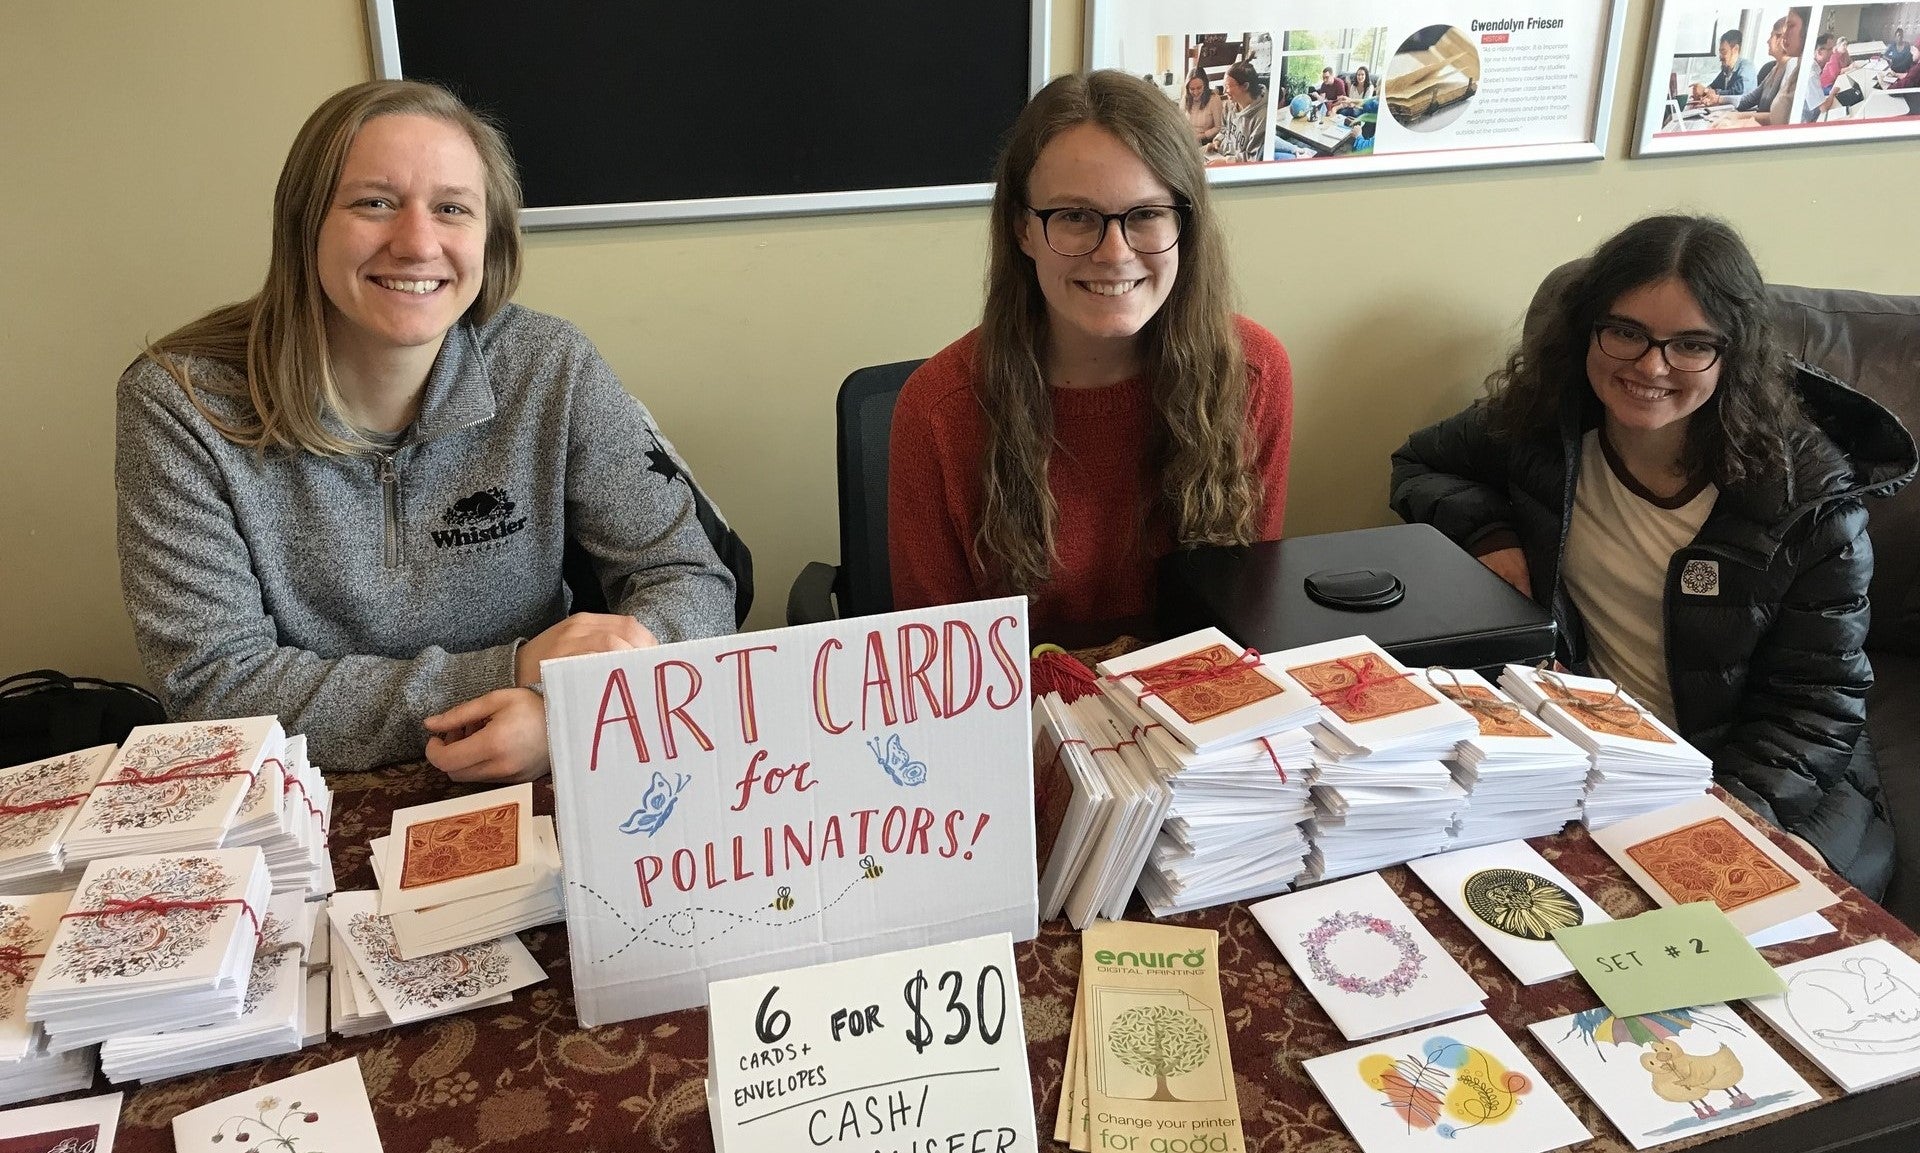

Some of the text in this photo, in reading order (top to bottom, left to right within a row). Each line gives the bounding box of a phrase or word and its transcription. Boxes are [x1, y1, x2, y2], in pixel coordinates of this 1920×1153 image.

[1471, 17, 1564, 32] Gwendolyn Friesen
[431, 516, 527, 548] Whistler
[457, 540, 509, 555] CANADA
[590, 616, 1024, 771] ART CARDS
[730, 749, 819, 811] for
[634, 805, 990, 908] POLLINATORS!
[1097, 966, 1143, 975] DIGITAL
[1596, 950, 1643, 973] SET
[755, 965, 1006, 1054] 6 FOR $30
[734, 1065, 828, 1107] ENVELOPES
[808, 1084, 929, 1146] CASH/
[1097, 1112, 1152, 1129] Change
[1156, 1119, 1188, 1130] your
[1191, 1117, 1237, 1131] printer
[1099, 1128, 1238, 1153] for good.
